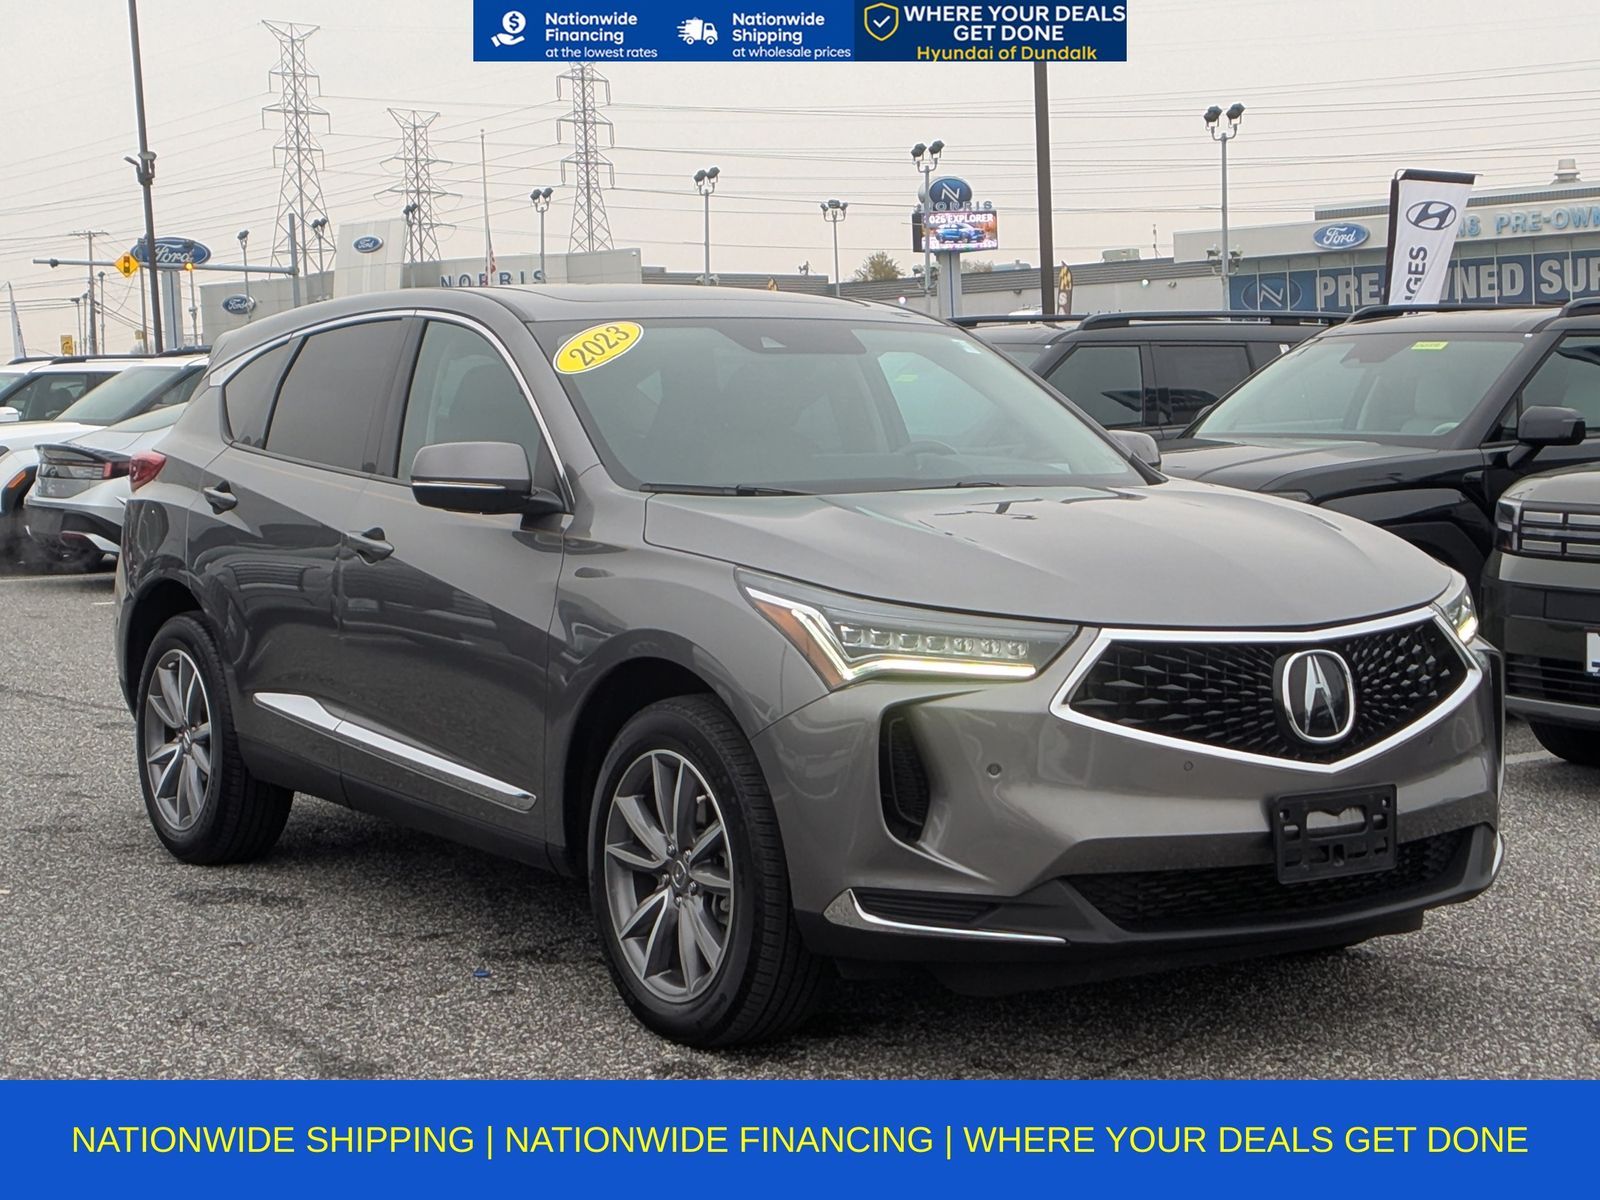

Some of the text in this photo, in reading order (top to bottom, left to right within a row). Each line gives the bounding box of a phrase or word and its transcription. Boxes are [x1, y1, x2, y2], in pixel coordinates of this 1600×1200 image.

[948, 213, 994, 224] EXPLORER
[1323, 227, 1356, 245] Ford
[569, 326, 630, 366] 2023
